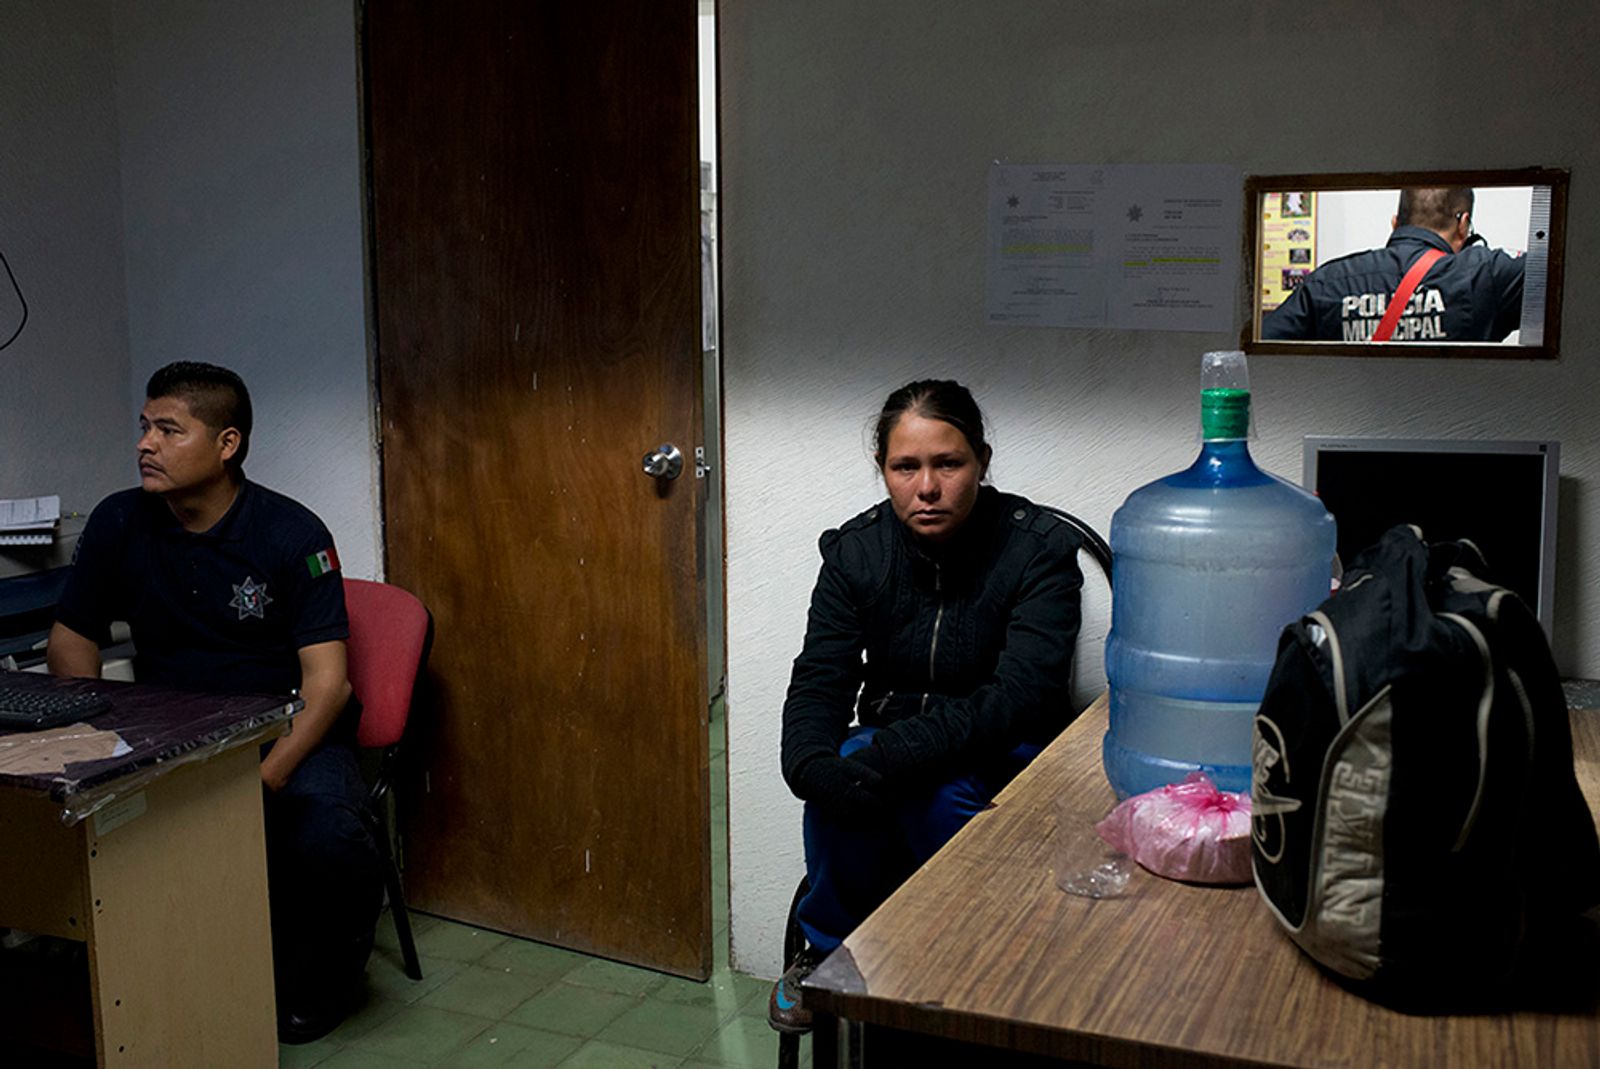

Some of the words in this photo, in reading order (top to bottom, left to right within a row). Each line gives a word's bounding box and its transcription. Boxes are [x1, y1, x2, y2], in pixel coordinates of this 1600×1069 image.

[1342, 285, 1446, 317] POLCÍA
[1342, 315, 1447, 341] MUCIPAL
[1324, 762, 1383, 926] NIKE
